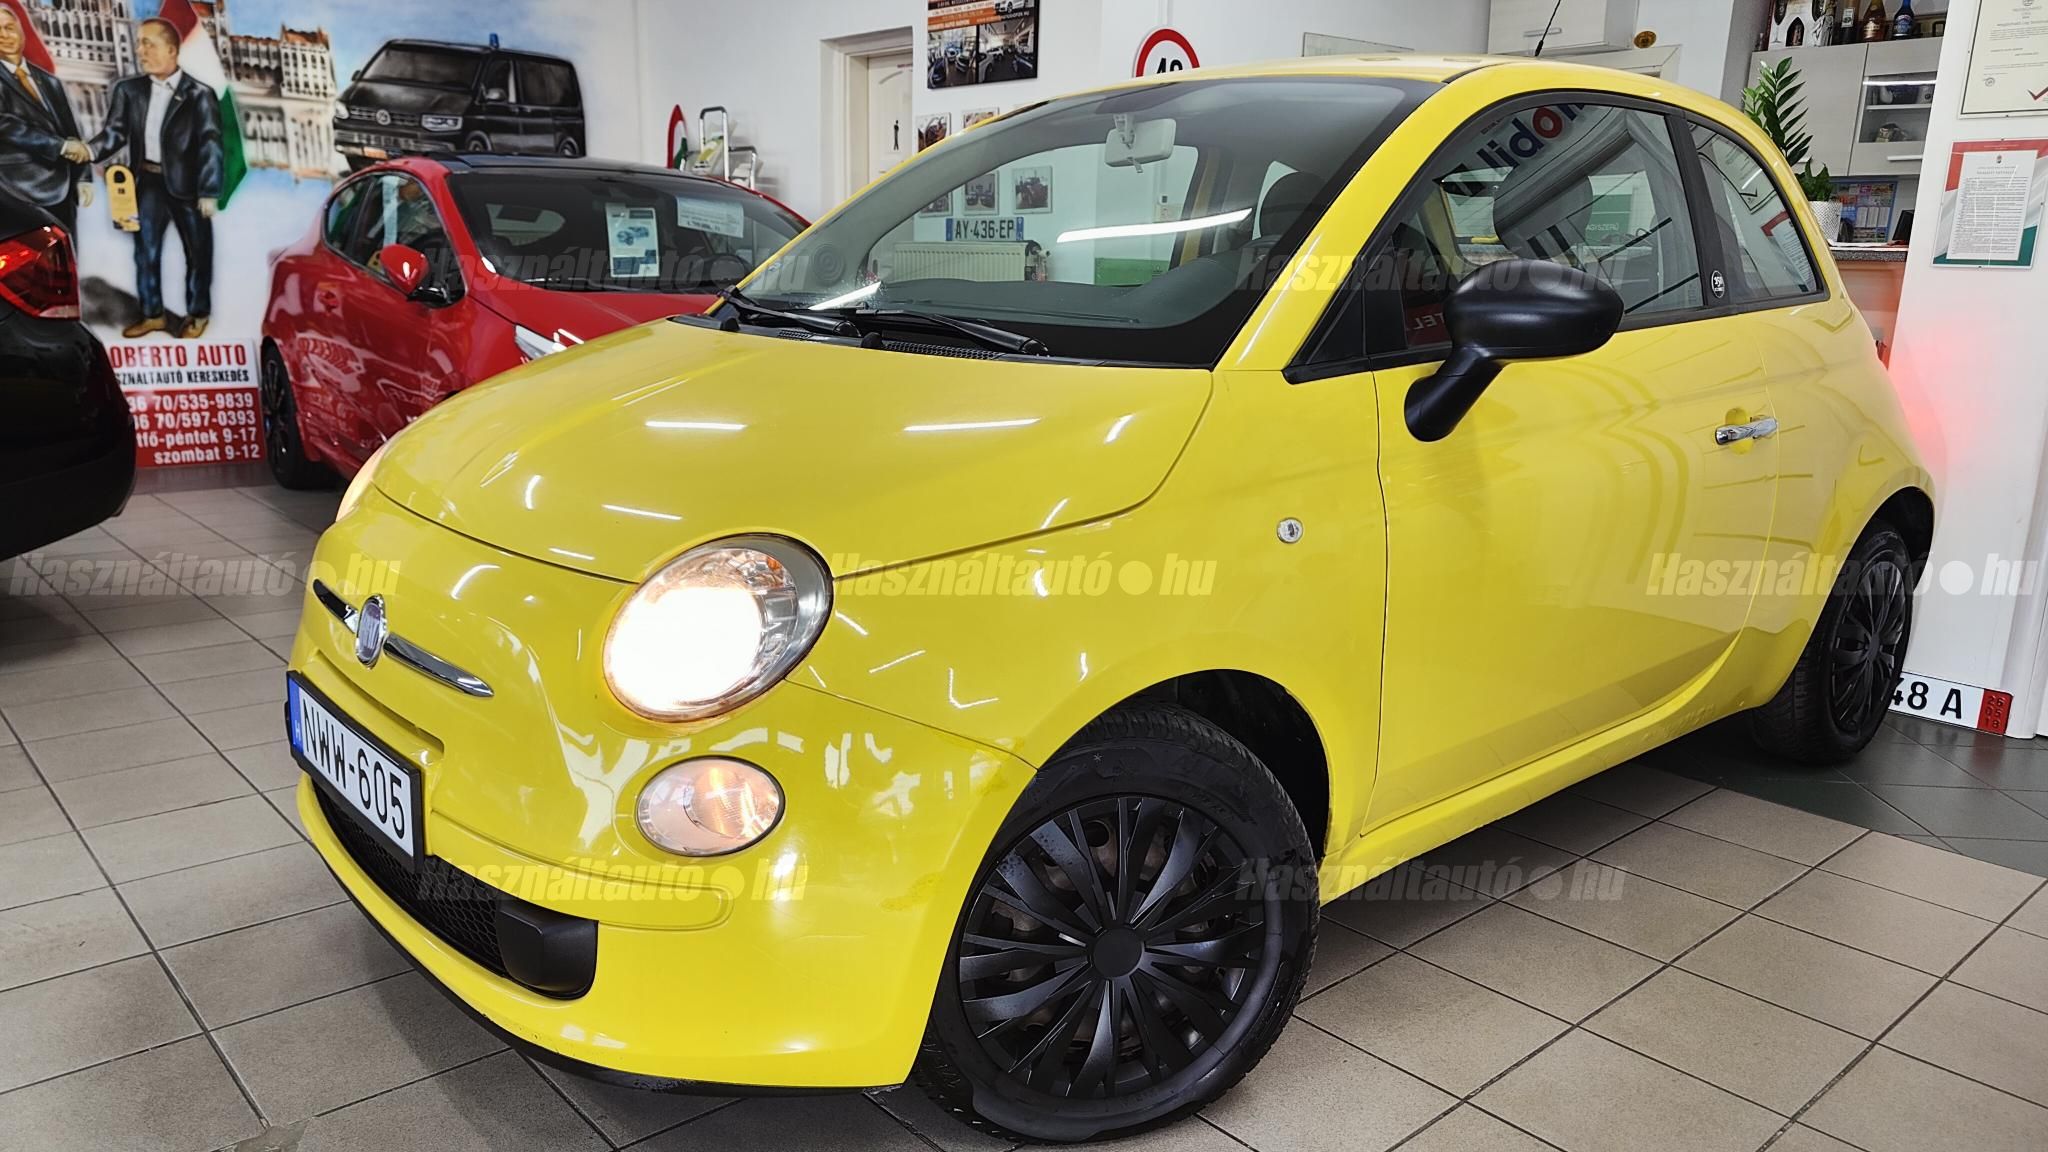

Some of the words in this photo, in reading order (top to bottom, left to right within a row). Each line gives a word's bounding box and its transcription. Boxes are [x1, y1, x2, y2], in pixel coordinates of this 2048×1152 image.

[197, 344, 247, 367] AUTO
[187, 368, 250, 383] KERESKEDÉS
[154, 392, 254, 412] 70/535-9839
[155, 410, 256, 430] 70/597-0393
[222, 427, 258, 443] 9-17
[154, 447, 221, 465] szombat
[224, 444, 260, 460] 9-12
[1939, 687, 1963, 720] A
[303, 698, 405, 840] NWW-605
